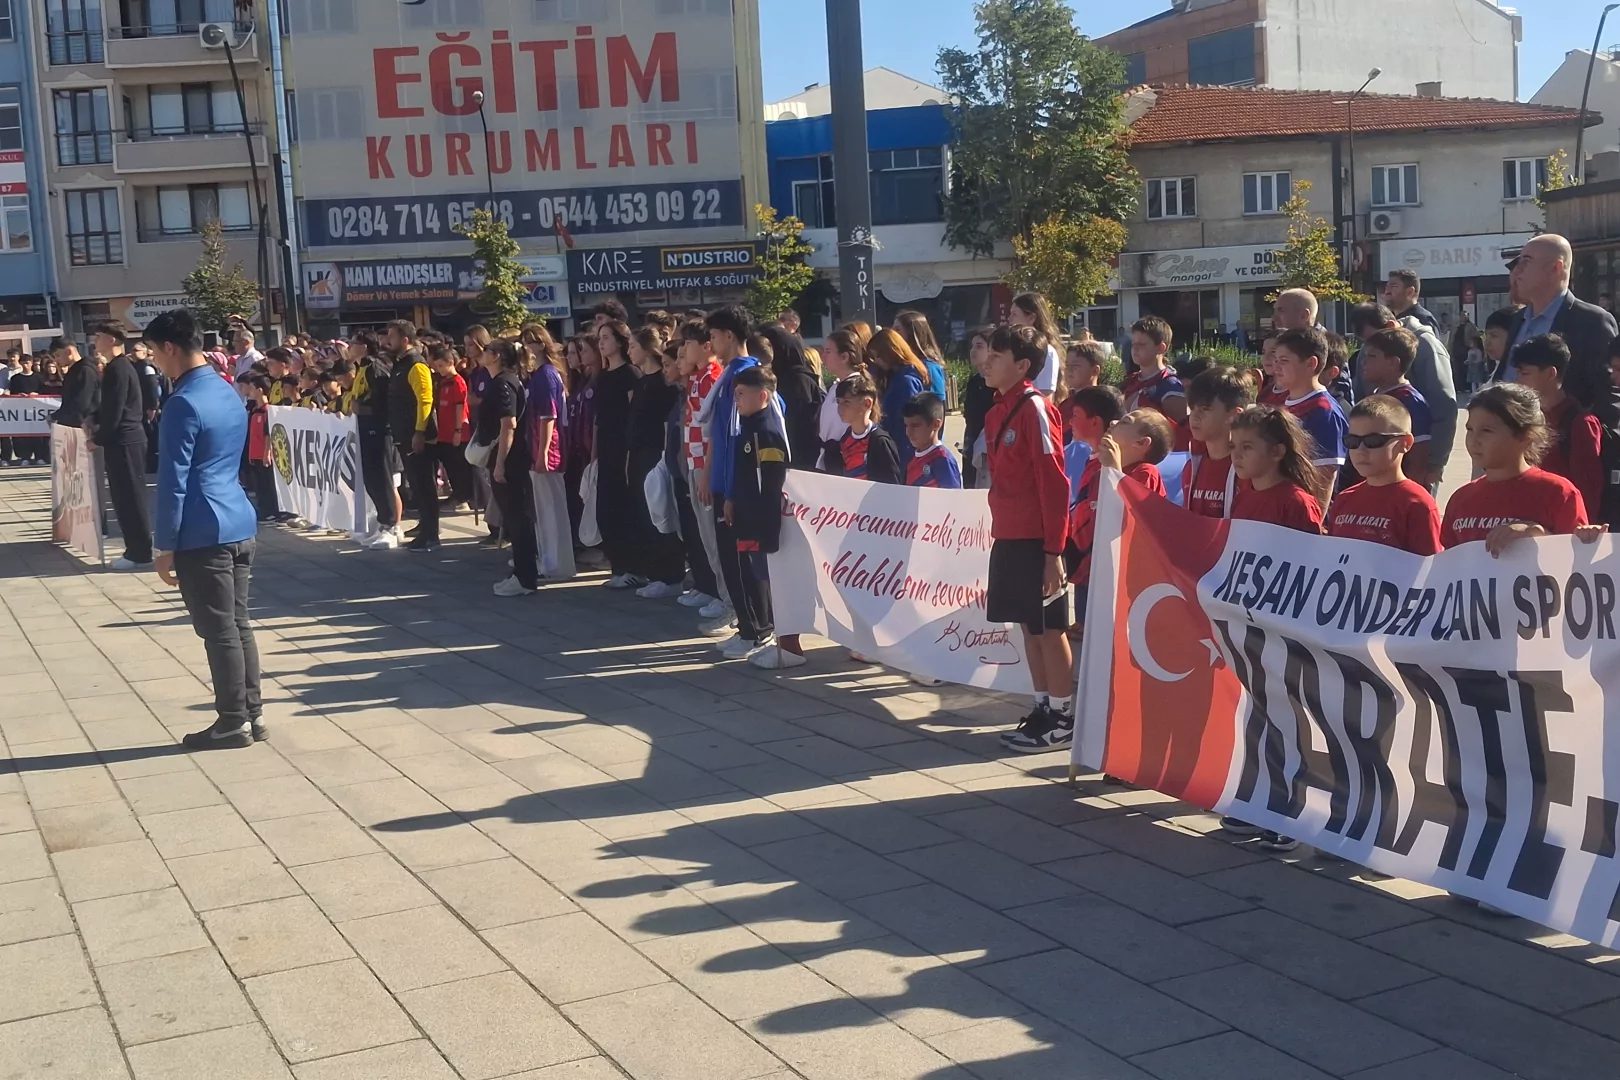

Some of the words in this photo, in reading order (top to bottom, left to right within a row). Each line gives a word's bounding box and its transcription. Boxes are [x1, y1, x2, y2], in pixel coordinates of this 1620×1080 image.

[372, 25, 680, 119] EĞİTİM
[366, 121, 698, 179] KURUMLARI
[328, 204, 389, 238] 0284
[394, 203, 441, 234] 714
[538, 195, 599, 229] 0544
[605, 192, 648, 225] 453
[656, 191, 685, 222] 09
[692, 189, 721, 219] 22
[582, 250, 643, 275] KARE
[1429, 247, 1482, 266] BARIŞ
[344, 266, 374, 288] HAN
[376, 263, 454, 287] KARDEŞLER
[656, 277, 701, 289] MUTFAK
[703, 276, 711, 286] &
[1170, 272, 1212, 283] mangal
[1235, 267, 1248, 276] VE
[346, 291, 374, 301] Döner
[376, 291, 388, 300] Ve
[389, 290, 421, 299] Yemek
[810, 506, 918, 539] sporcunun
[921, 512, 954, 549] zeki,
[1356, 515, 1391, 529] KARATE
[1477, 517, 1521, 529] KARA
[1315, 553, 1436, 637] ÖNDER
[1512, 572, 1617, 641] SPOR
